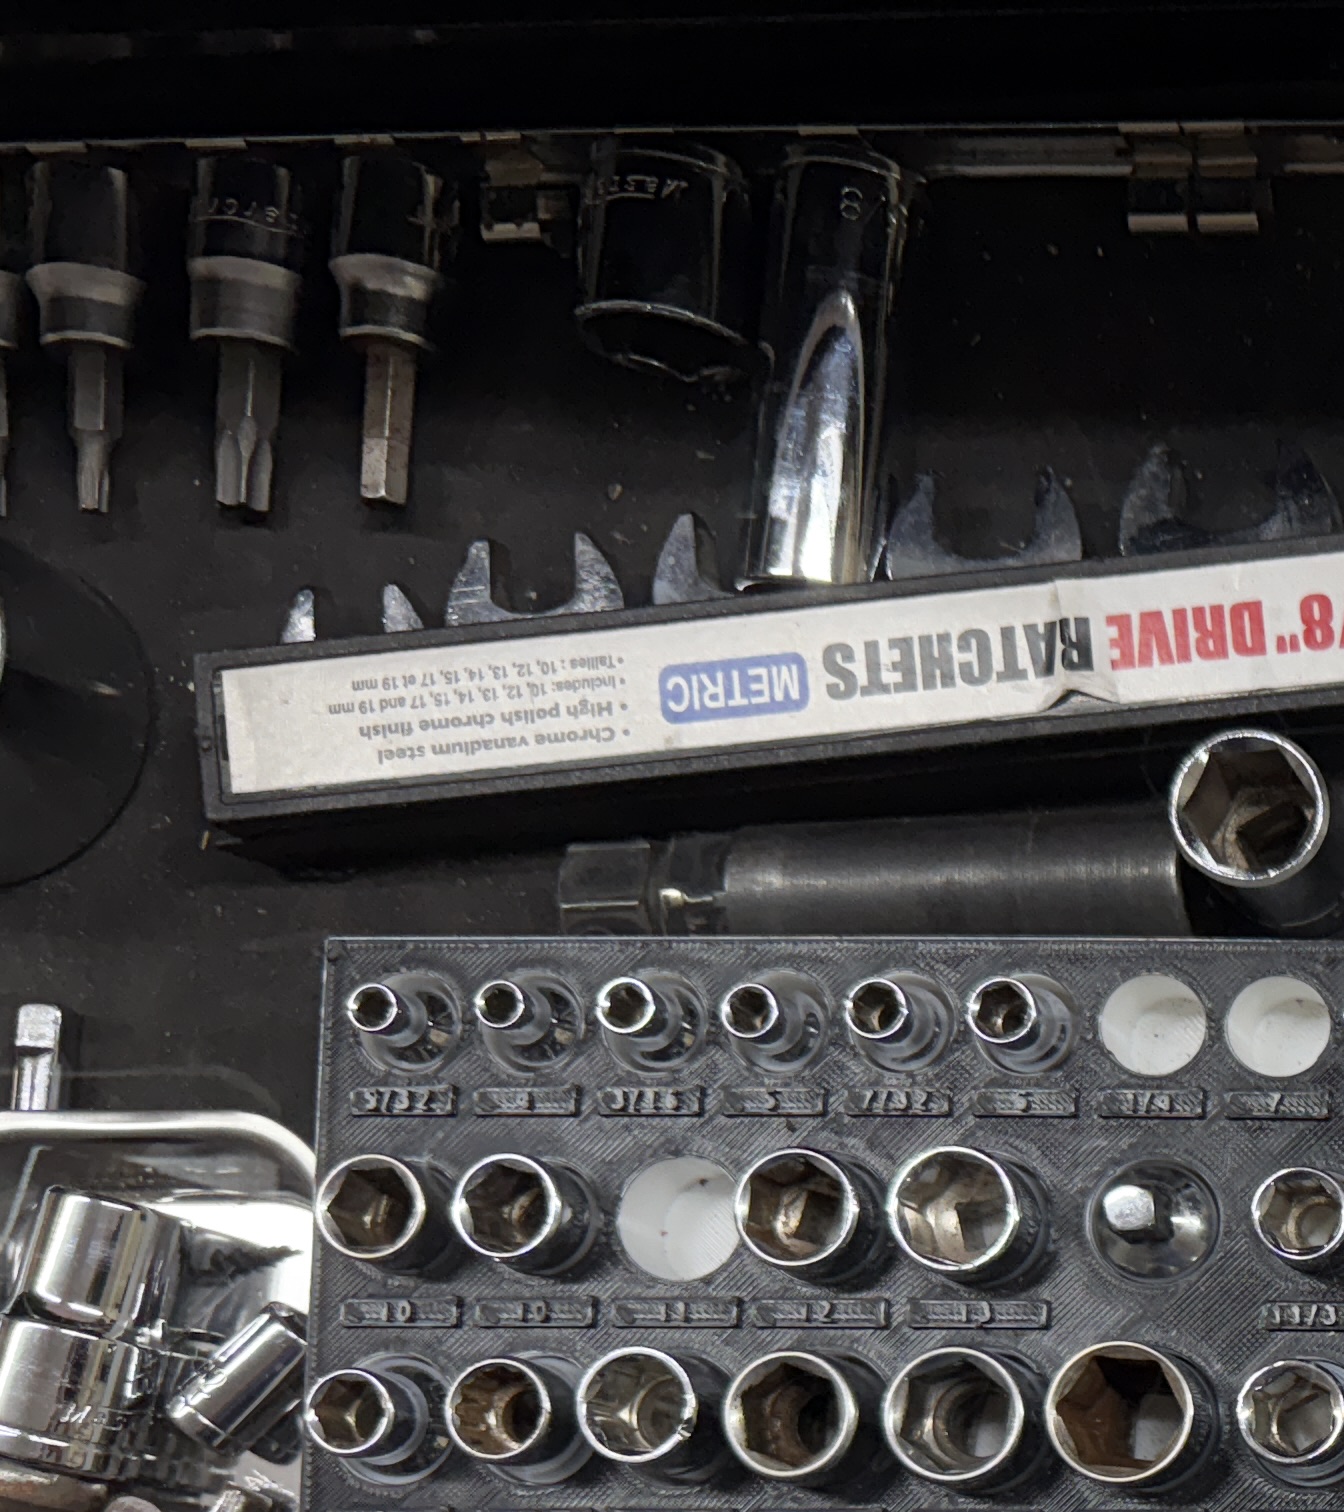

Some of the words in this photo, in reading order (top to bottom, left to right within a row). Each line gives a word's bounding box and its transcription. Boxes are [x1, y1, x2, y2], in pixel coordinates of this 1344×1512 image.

[1109, 600, 1267, 670] DRIVE
[822, 615, 1094, 702] RATCHETS
[351, 679, 378, 693] mm
[382, 676, 400, 692] 19
[421, 673, 436, 688] 17
[551, 675, 615, 697] Includes:
[666, 661, 801, 711] METRIC
[328, 703, 354, 716] mm
[359, 699, 376, 714] 19
[379, 697, 407, 713] and
[410, 694, 426, 709] 17
[500, 703, 560, 731] polish
[565, 700, 613, 723] High
[358, 721, 413, 740] finish
[418, 713, 495, 733] chrome
[431, 735, 529, 755] vanadium
[534, 726, 615, 745] Chrome
[376, 745, 426, 765] steel
